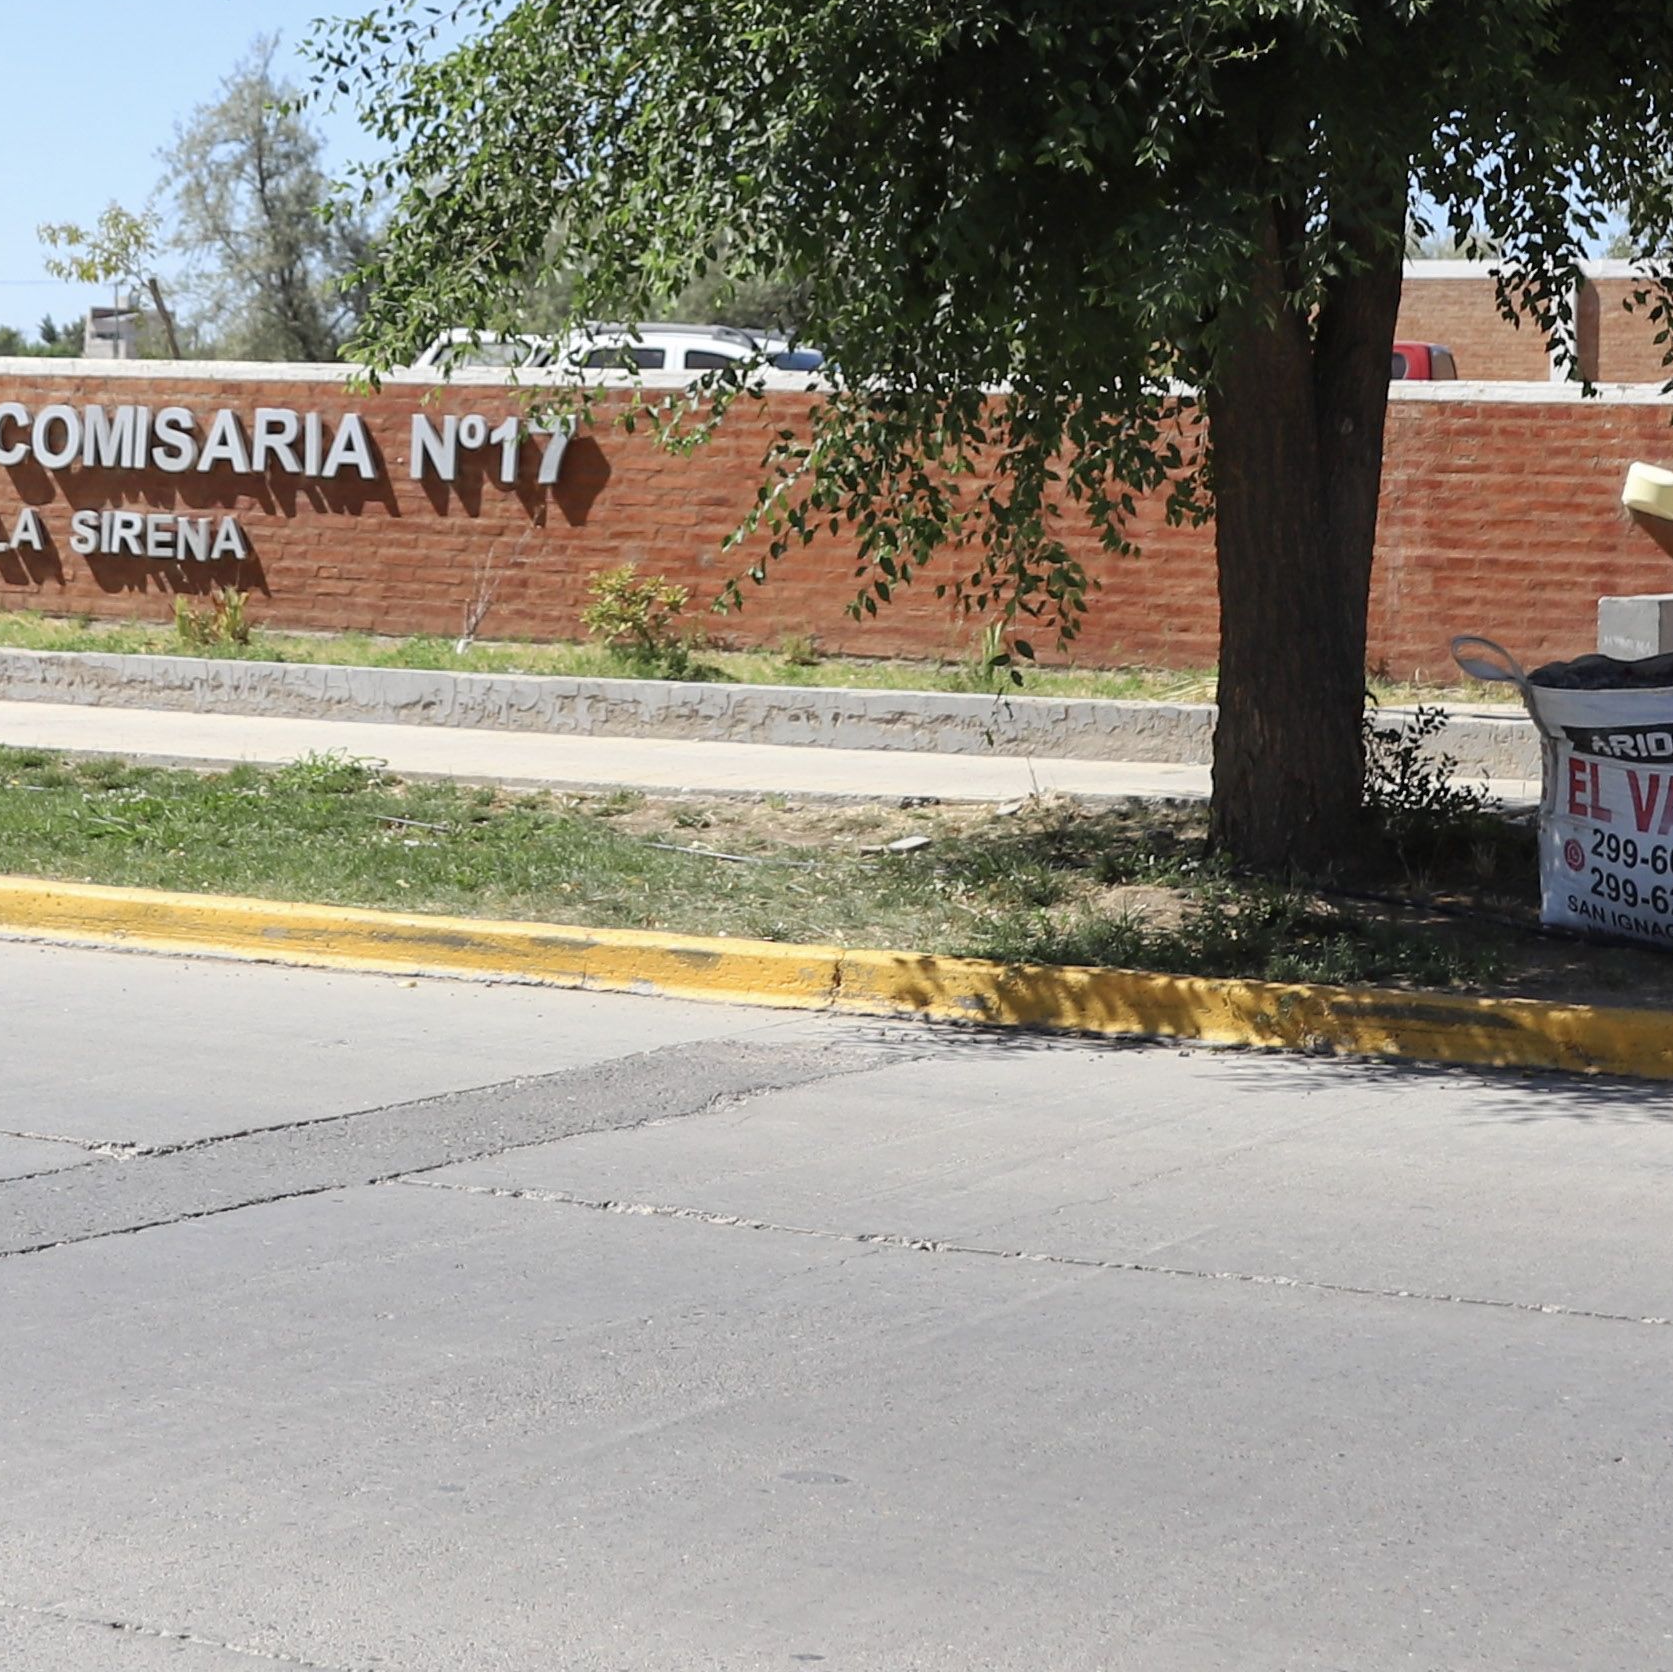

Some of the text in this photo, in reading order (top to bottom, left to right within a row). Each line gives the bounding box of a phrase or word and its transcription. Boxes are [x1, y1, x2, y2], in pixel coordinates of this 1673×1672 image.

[70, 509, 247, 562] SIRENA
[1568, 757, 1613, 824] EL
[1567, 894, 1605, 923] SAN
